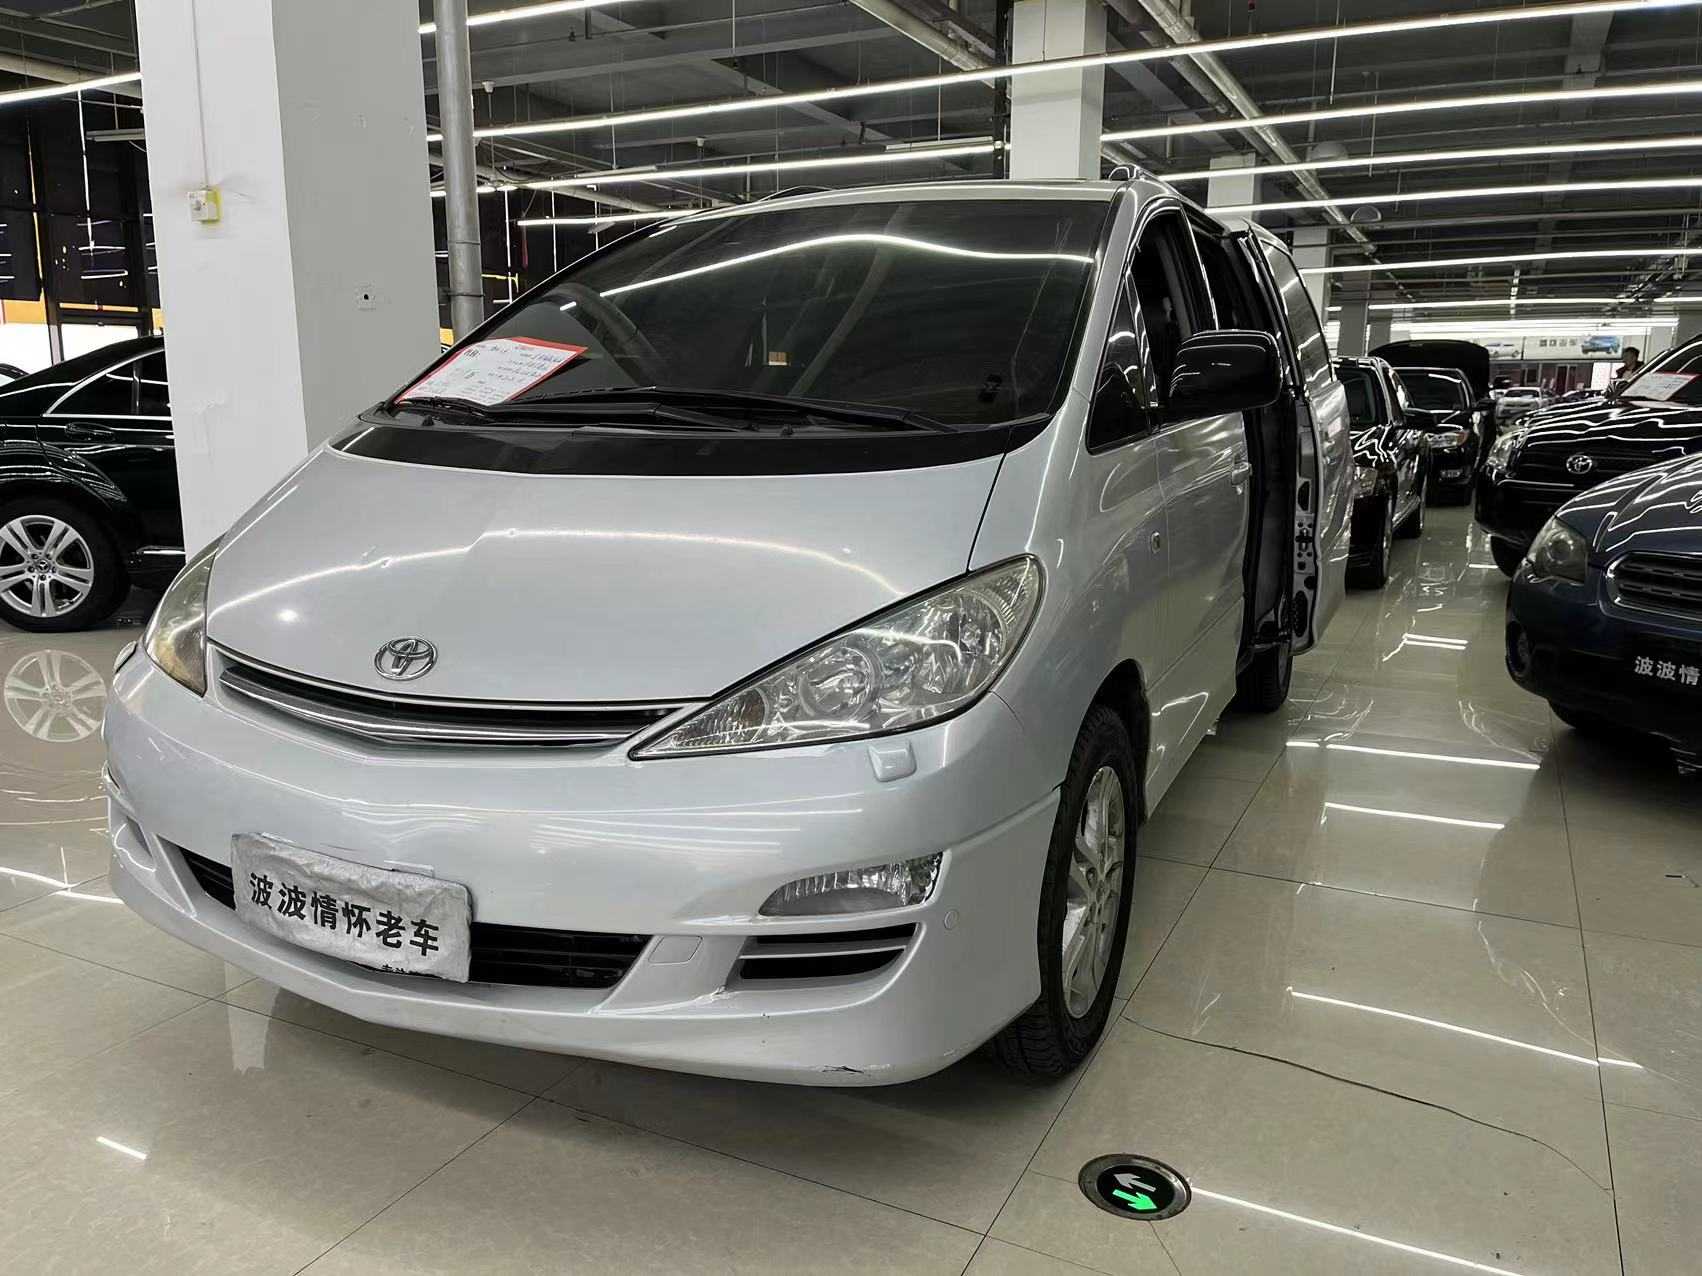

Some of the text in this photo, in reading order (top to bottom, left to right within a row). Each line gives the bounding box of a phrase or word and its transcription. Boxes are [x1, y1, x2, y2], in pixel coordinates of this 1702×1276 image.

[1634, 656, 1700, 685] 波波情
[250, 872, 440, 956] 波波情怀老车
